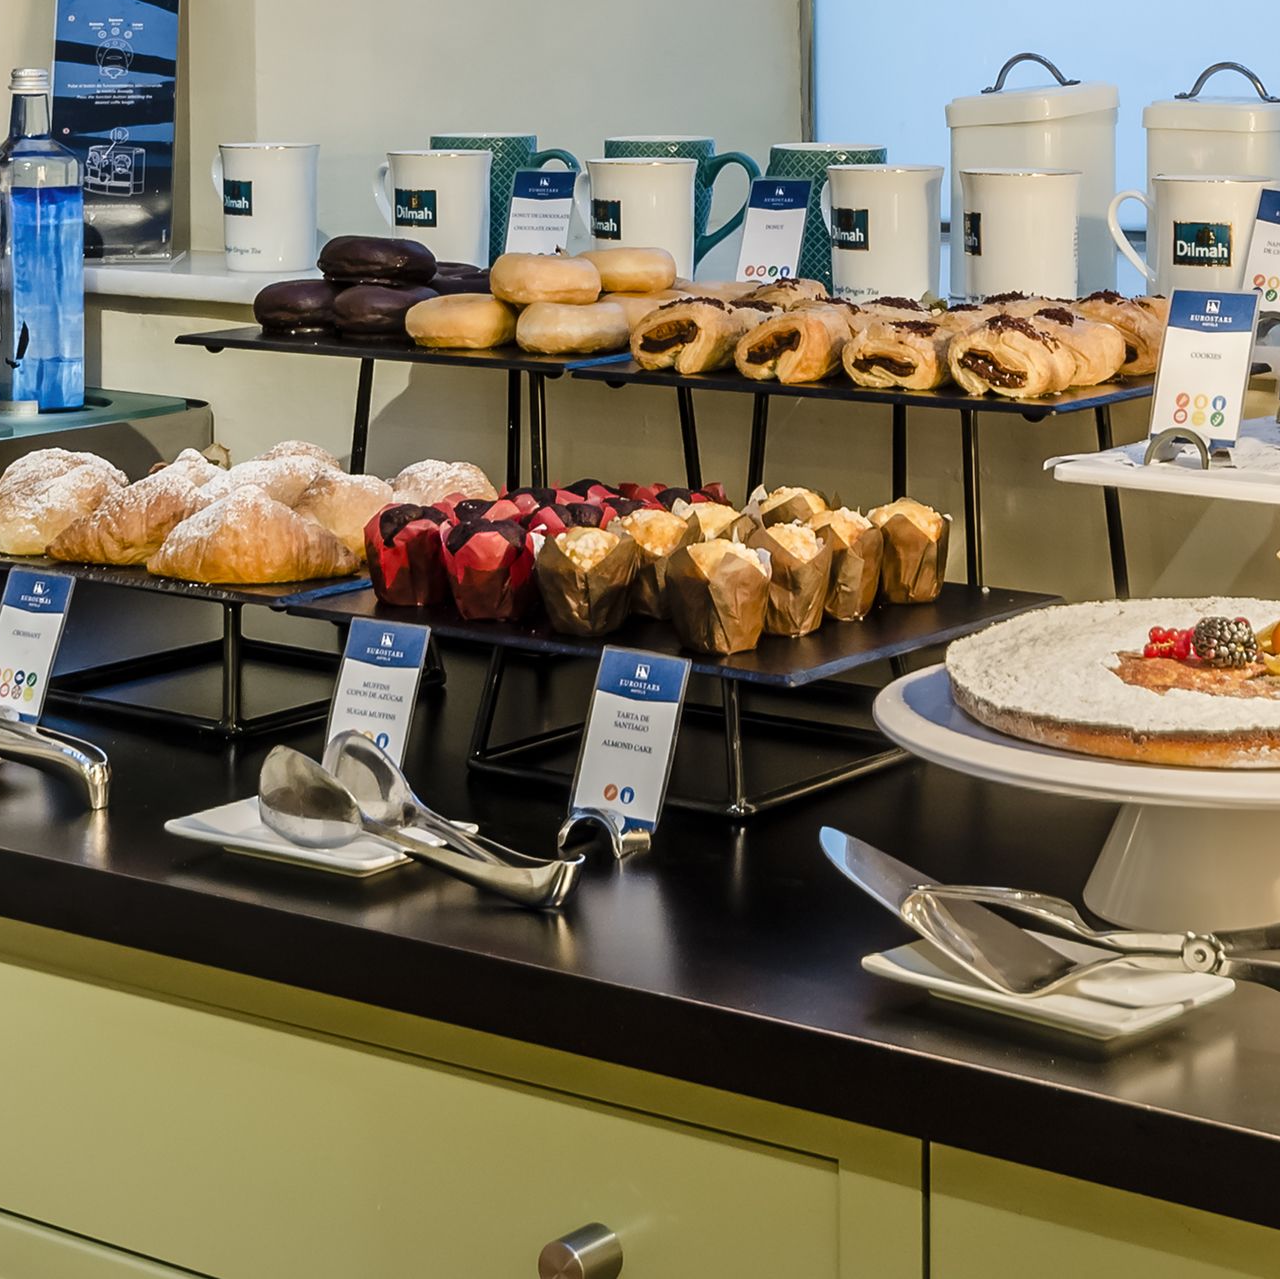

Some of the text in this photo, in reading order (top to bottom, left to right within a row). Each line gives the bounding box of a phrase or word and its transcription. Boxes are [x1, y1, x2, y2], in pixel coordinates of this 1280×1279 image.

[396, 205, 432, 220] Dilmah
[1176, 240, 1228, 258] Dilmah
[846, 286, 864, 296] Origin
[1190, 314, 1232, 324] EUROSTARS
[1190, 352, 1222, 360] COOKIES
[12, 629, 41, 639] CROISSANT
[366, 647, 404, 658] EUROSTARS
[362, 681, 390, 691] MUFFINS
[620, 678, 660, 692] EUROSTARS
[346, 688, 368, 697] COPOS
[368, 690, 376, 698] DE
[346, 707, 396, 720] SUGAR MUFFINS
[616, 710, 650, 722] TARTA DE
[614, 721, 650, 732] SANTIAGO
[601, 739, 652, 754] ALMOND CAKE
